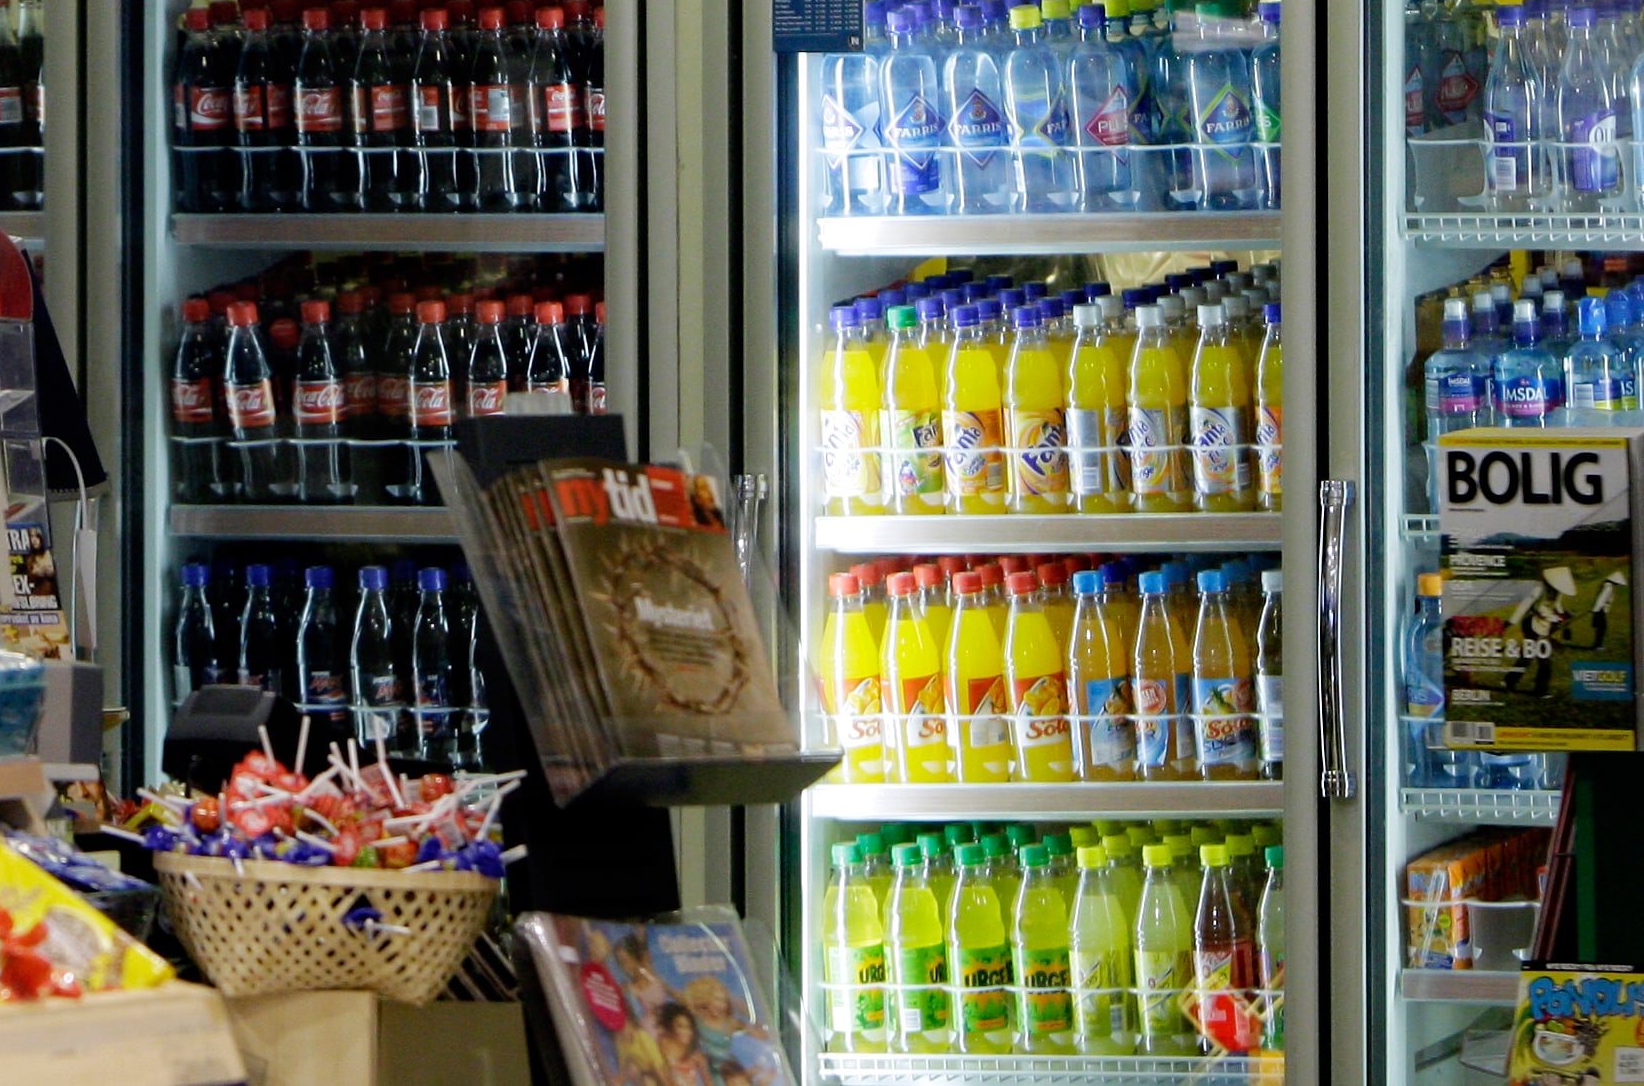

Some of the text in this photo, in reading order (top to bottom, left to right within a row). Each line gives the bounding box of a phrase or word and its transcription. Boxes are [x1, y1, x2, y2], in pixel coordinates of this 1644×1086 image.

[1447, 451, 1603, 505] BOLIG
[1451, 637, 1553, 659] REISE & BO
